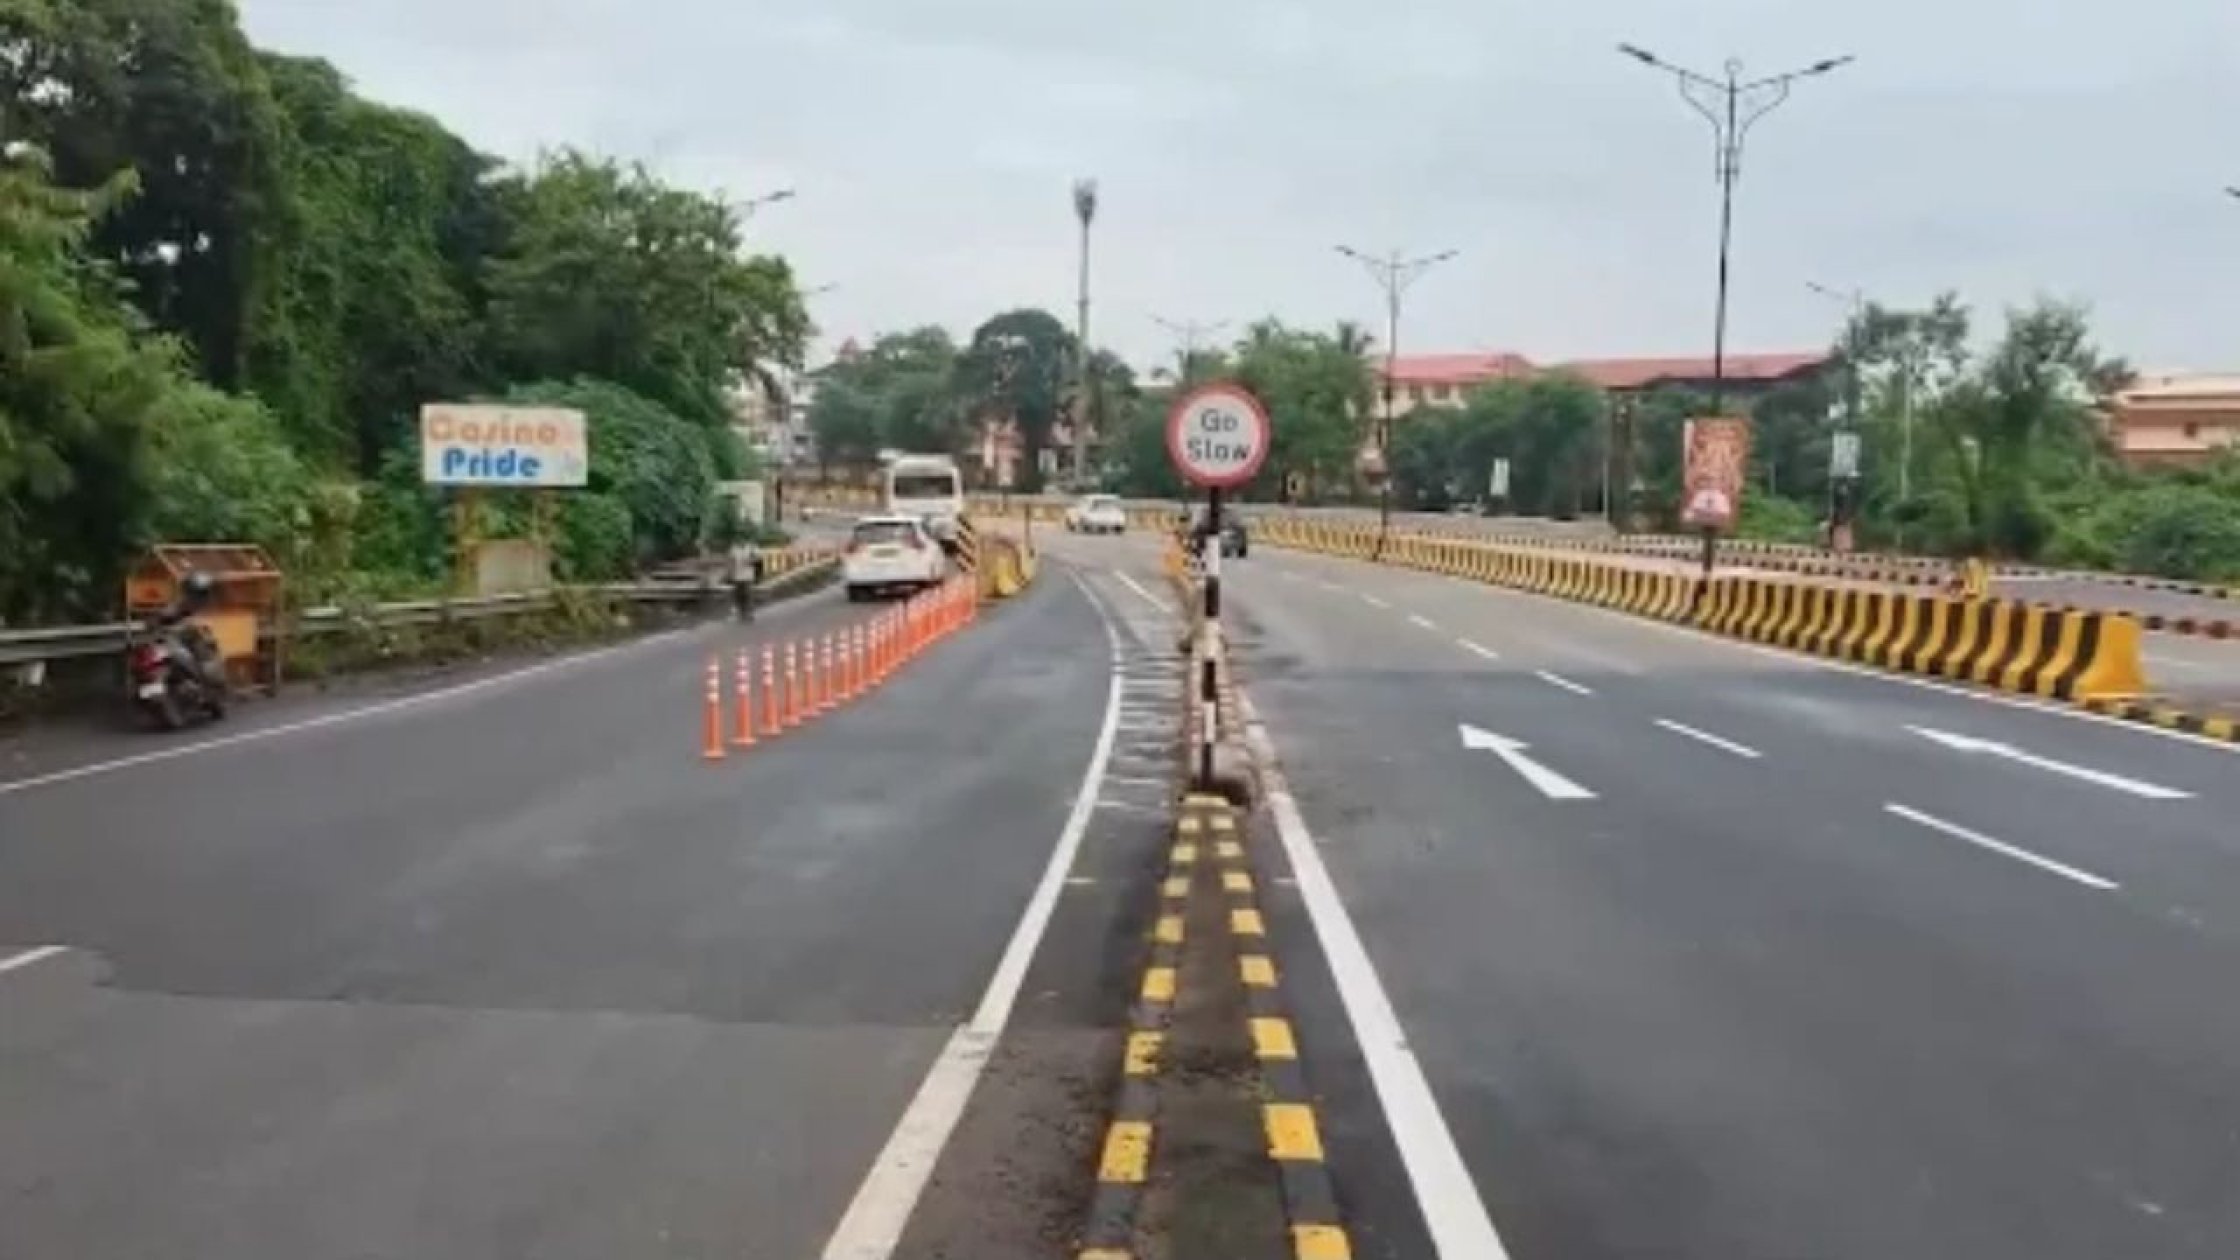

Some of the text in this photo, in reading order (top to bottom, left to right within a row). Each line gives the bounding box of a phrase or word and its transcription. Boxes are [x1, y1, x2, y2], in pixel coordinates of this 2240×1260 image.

[429, 413, 557, 444] Casino
[1201, 408, 1239, 432] Go
[442, 447, 542, 478] Pride
[1187, 438, 1251, 461] Slow
